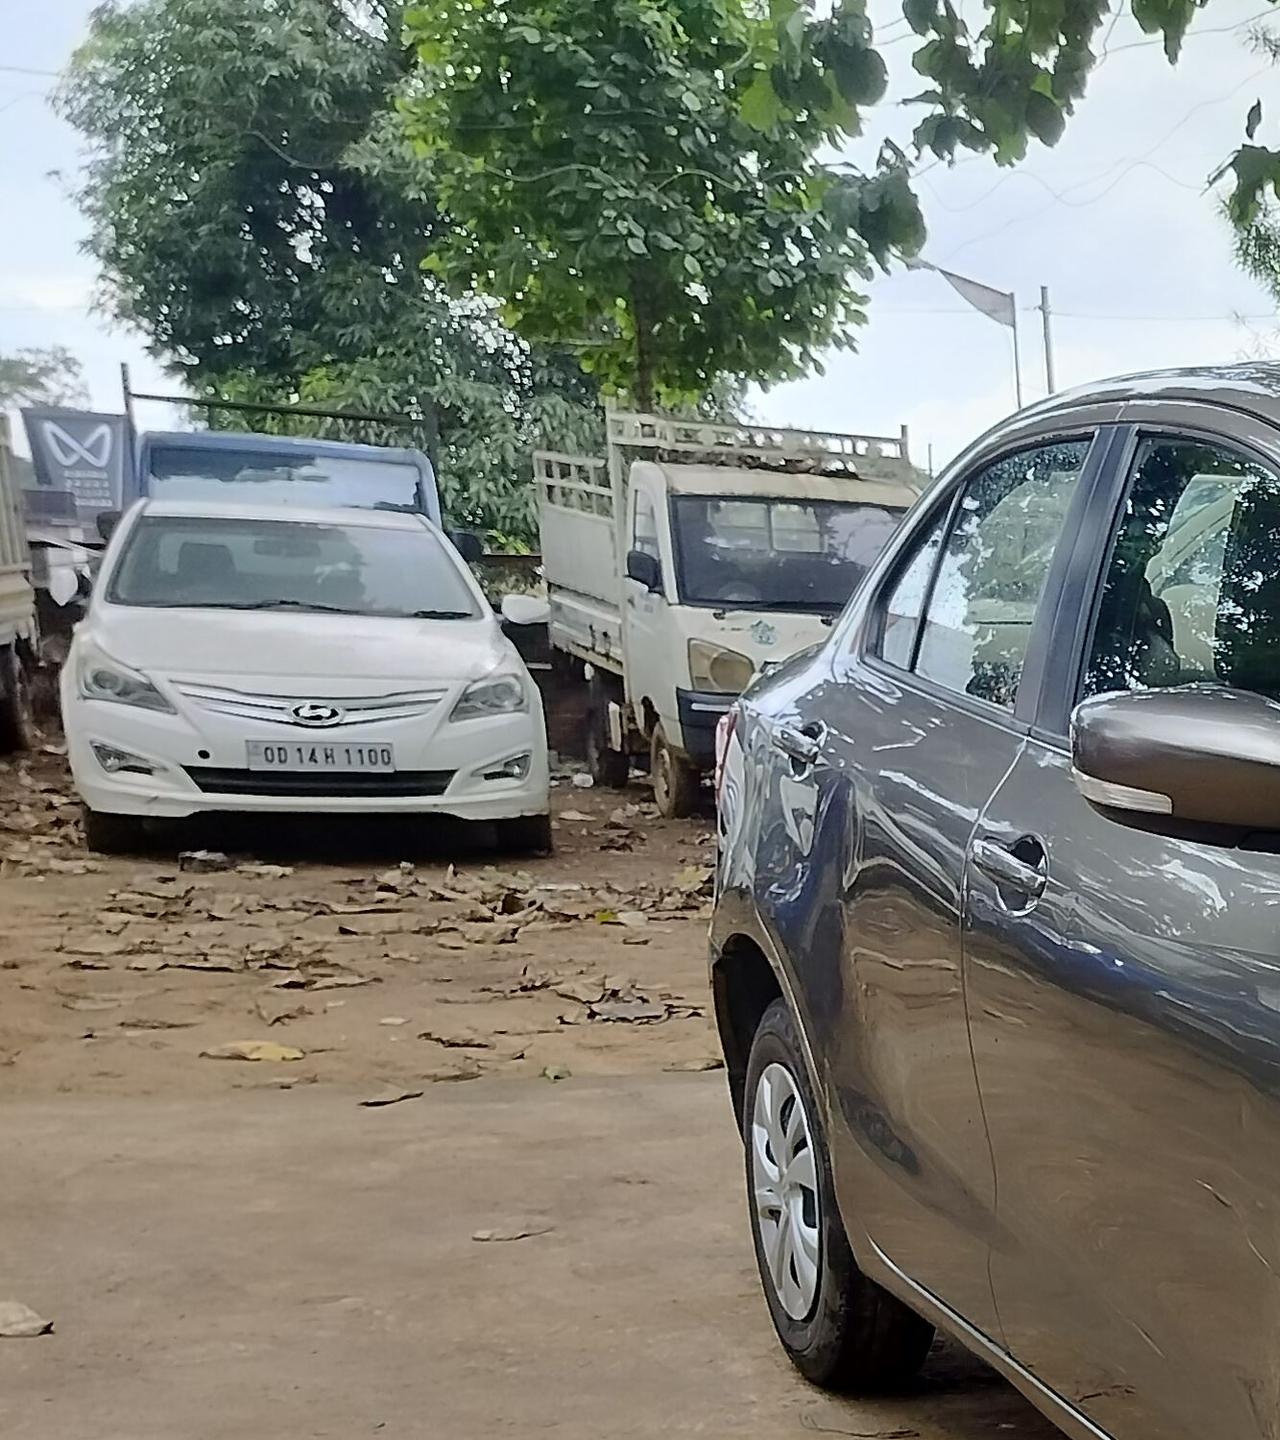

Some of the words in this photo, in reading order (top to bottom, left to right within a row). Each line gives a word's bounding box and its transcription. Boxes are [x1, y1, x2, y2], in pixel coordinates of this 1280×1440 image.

[296, 748, 319, 765] 14
[323, 748, 336, 765] H
[345, 748, 392, 766] 1100
